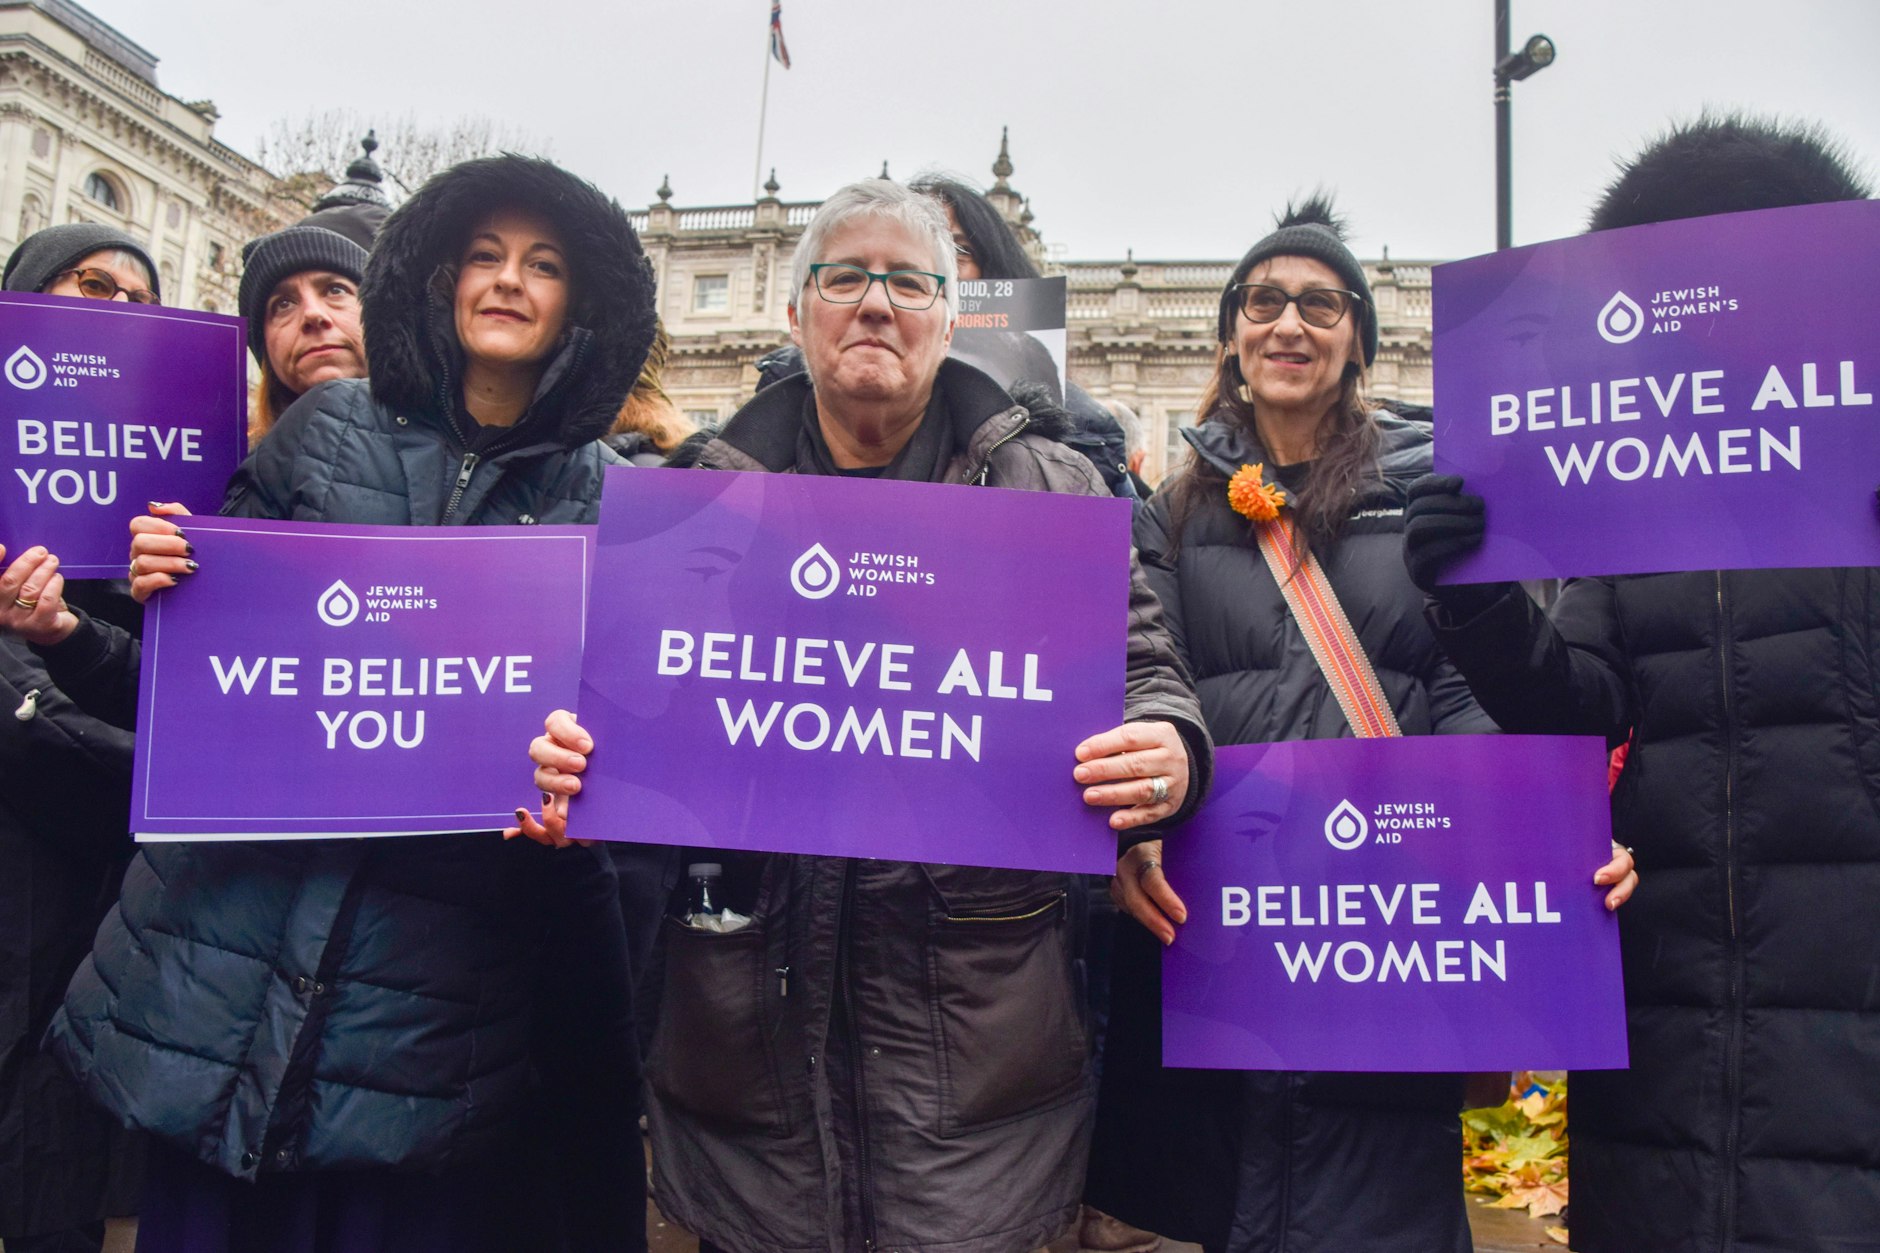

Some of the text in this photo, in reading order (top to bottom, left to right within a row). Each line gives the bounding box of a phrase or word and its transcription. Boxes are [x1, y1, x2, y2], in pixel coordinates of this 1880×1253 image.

[994, 281, 1014, 297] 28
[1652, 286, 1719, 302] JEWISH
[968, 300, 982, 312] BY
[1652, 299, 1738, 318] WOMEN'S
[1652, 320, 1682, 334] AID
[52, 353, 106, 365] JEWISH
[53, 366, 120, 378] WOMEN'S
[53, 377, 78, 388] AID
[1491, 361, 1872, 435] BELIEVE ALL
[18, 420, 202, 461] BELIEVE
[1544, 426, 1800, 486] WOMEN
[15, 469, 116, 505] YOU
[850, 553, 918, 567] JEWISH
[849, 568, 934, 584] WOMEN'S
[367, 586, 423, 596] JEWISH
[846, 583, 878, 597] AID
[367, 599, 437, 609] WOMEN'S
[364, 611, 391, 623] AID
[658, 630, 1052, 701] BELIEVE ALL
[209, 656, 532, 695] WE BELIEVE
[316, 711, 424, 749] YOU
[716, 698, 982, 762] WOMEN
[1375, 803, 1434, 815] JEWISH
[1375, 817, 1450, 829] WOMEN'S
[1375, 832, 1402, 844] AID
[1222, 882, 1561, 926] BELIEVE ALL
[1274, 940, 1506, 982] WOMEN
